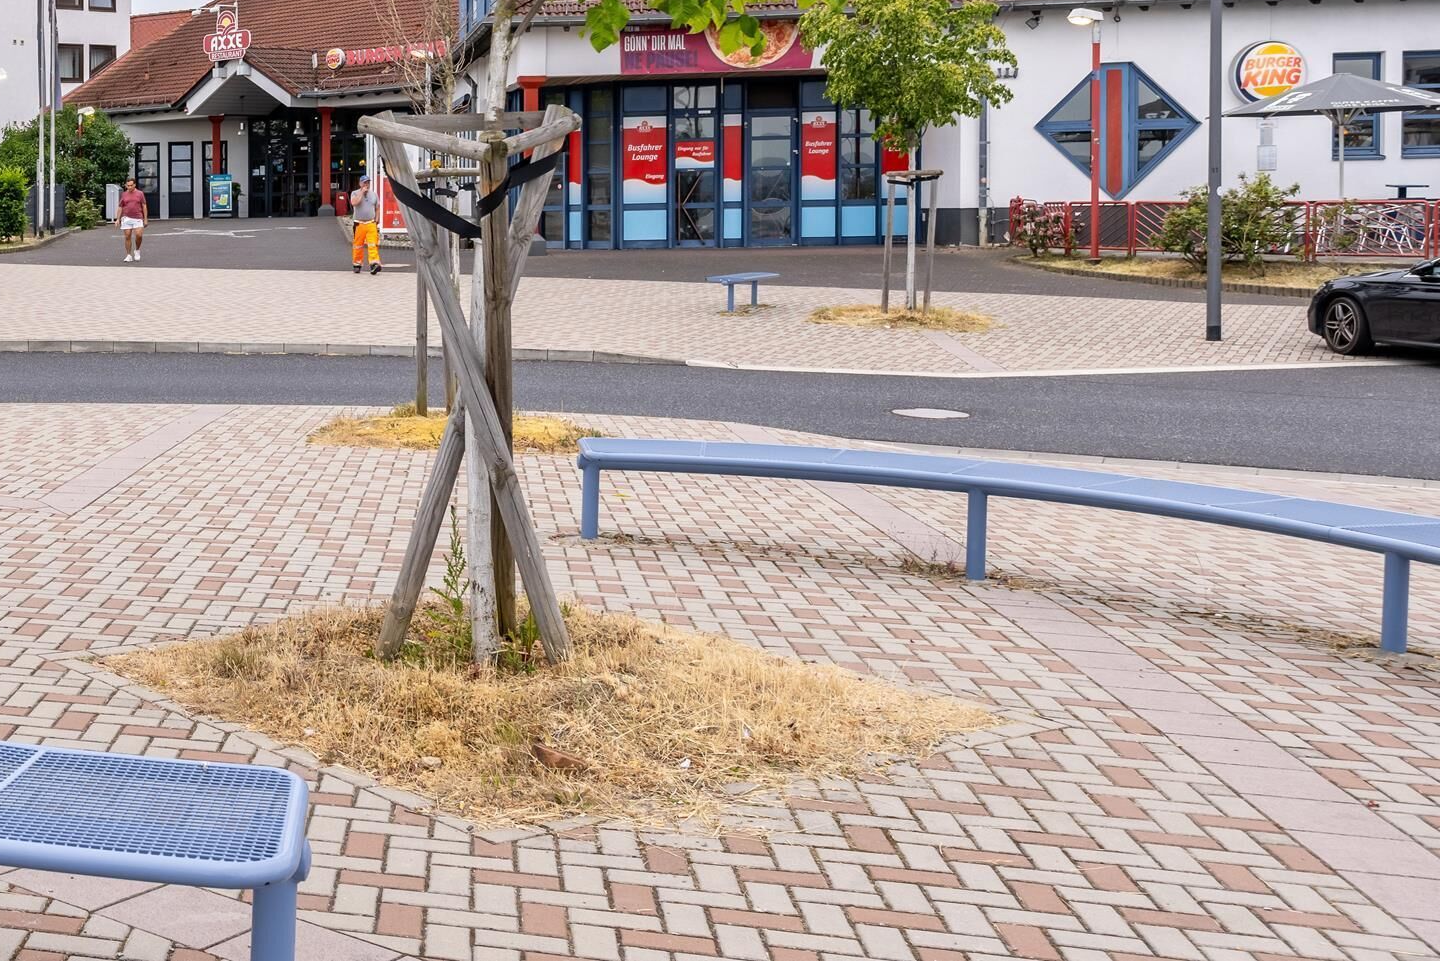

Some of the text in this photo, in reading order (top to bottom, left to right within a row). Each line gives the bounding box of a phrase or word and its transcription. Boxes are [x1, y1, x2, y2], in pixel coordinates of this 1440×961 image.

[211, 33, 243, 51] AXXE
[651, 35, 666, 51] DIR
[668, 34, 686, 50] MAL
[212, 50, 242, 59] RESTAURANT
[346, 46, 403, 65] BURGER
[1245, 56, 1301, 70] BURGER
[1242, 68, 1301, 88] KING
[627, 144, 662, 152] Busfahrer
[632, 153, 658, 162] Lounge
